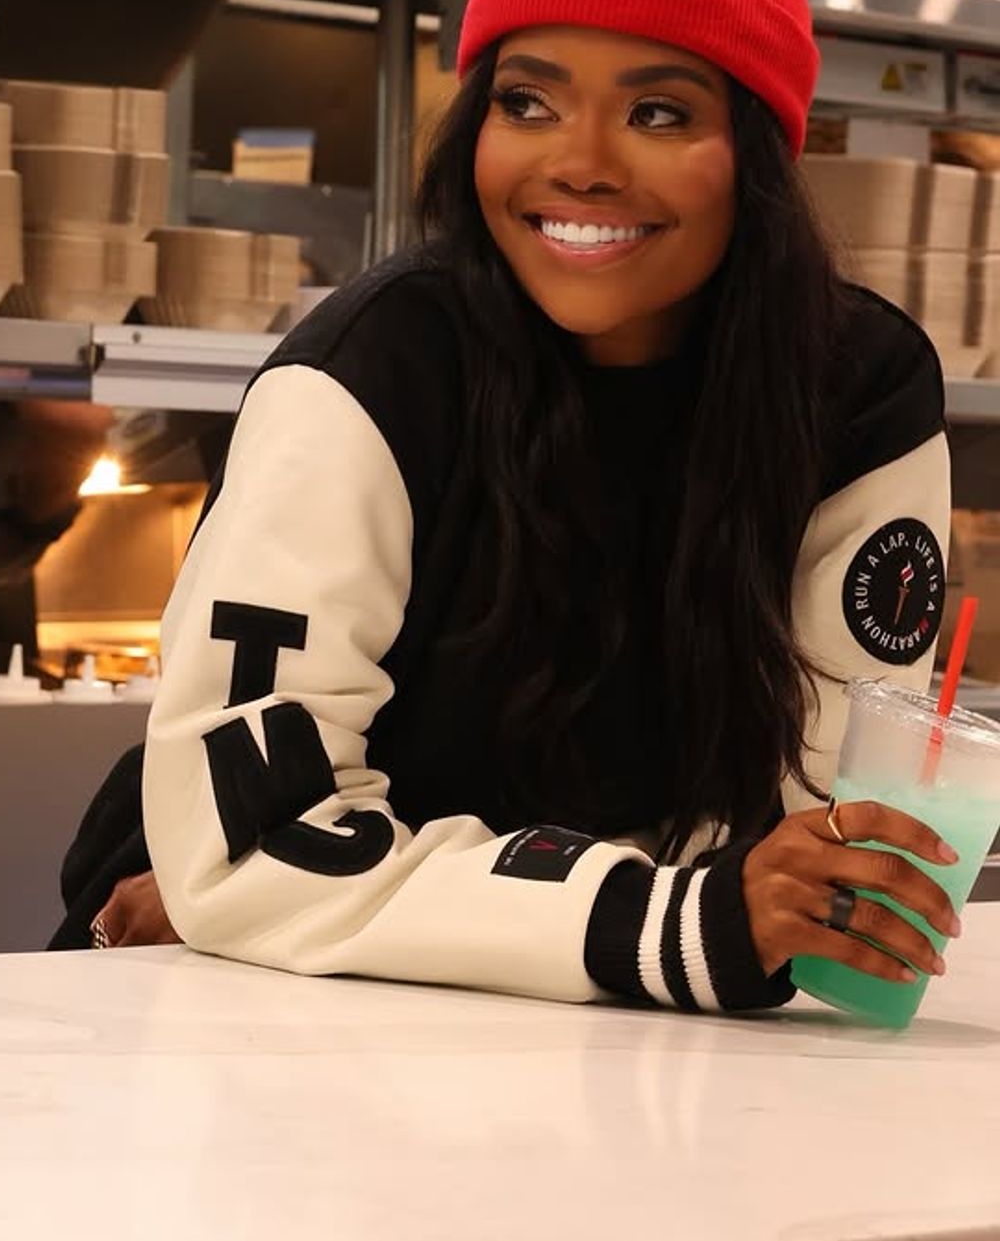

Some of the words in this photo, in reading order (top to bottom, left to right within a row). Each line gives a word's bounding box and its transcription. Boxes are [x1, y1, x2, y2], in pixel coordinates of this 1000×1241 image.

[867, 554, 879, 568] A
[915, 536, 935, 568] LIFE
[854, 572, 872, 610] RUN
[928, 574, 938, 593] IS
[926, 600, 936, 611] A
[861, 615, 930, 651] MARATHON
